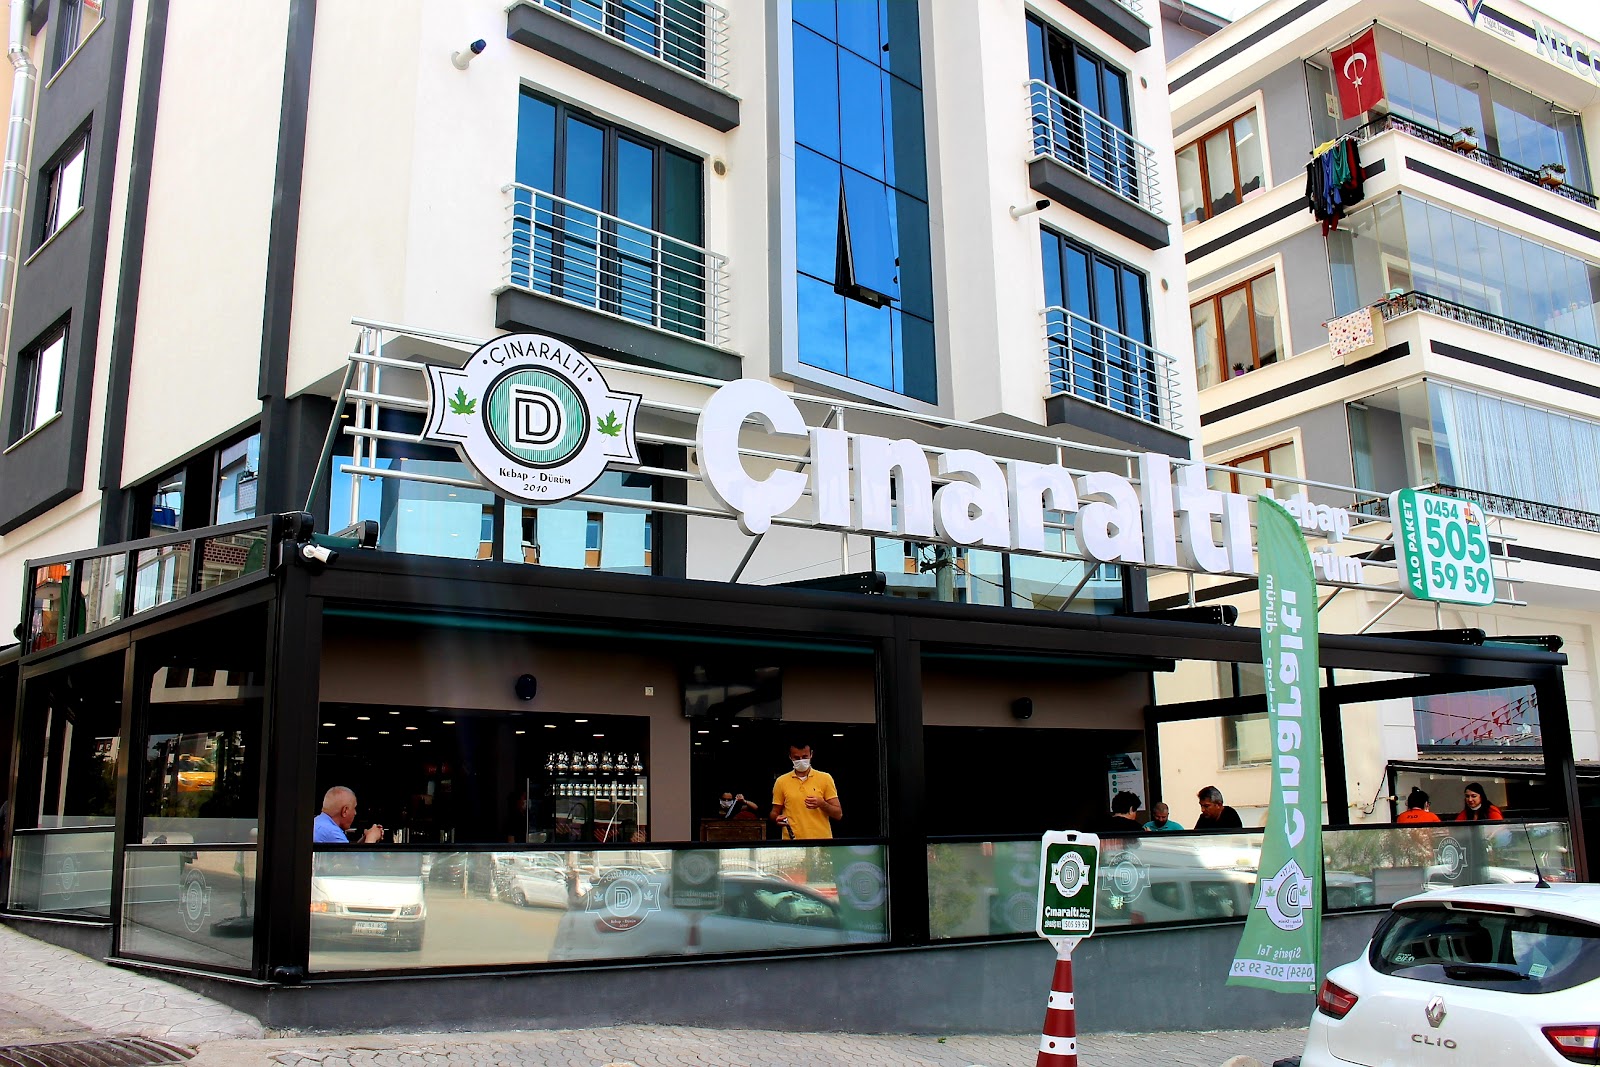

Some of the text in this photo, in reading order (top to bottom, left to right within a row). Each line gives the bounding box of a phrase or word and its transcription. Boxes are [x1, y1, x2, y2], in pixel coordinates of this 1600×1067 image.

[490, 341, 588, 379] ÇINARALTI
[523, 483, 548, 493] 2010
[696, 379, 1253, 576] Çınaraltı
[1267, 488, 1349, 543] ebap
[1424, 498, 1458, 519] 0454
[1403, 499, 1423, 590] ALO PAKET
[1426, 517, 1486, 563] 505
[1310, 546, 1364, 583] rüm
[1431, 560, 1489, 594] 59 59
[1045, 905, 1079, 918] Çınaraltı
[1411, 1033, 1457, 1049] CLIO
